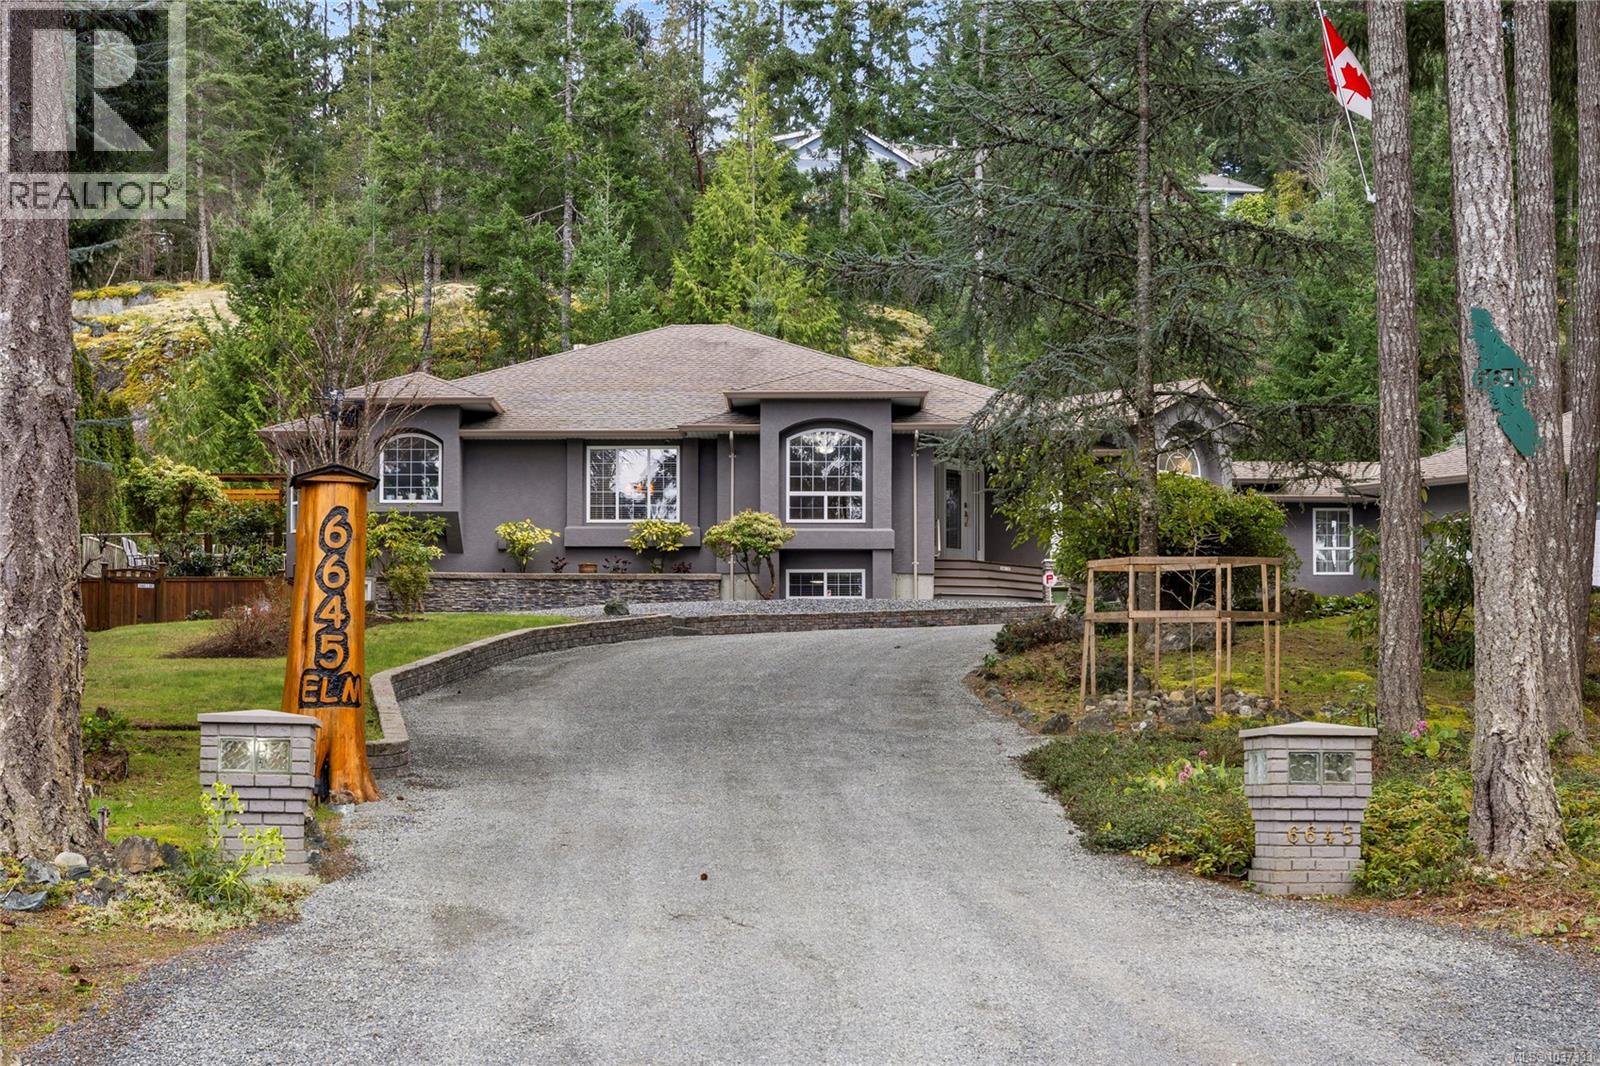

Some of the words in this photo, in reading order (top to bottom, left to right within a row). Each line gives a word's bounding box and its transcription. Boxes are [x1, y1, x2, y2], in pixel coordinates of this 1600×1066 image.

[318, 512, 349, 670] 6645
[301, 674, 361, 704] ELM
[1287, 824, 1354, 844] 6645
